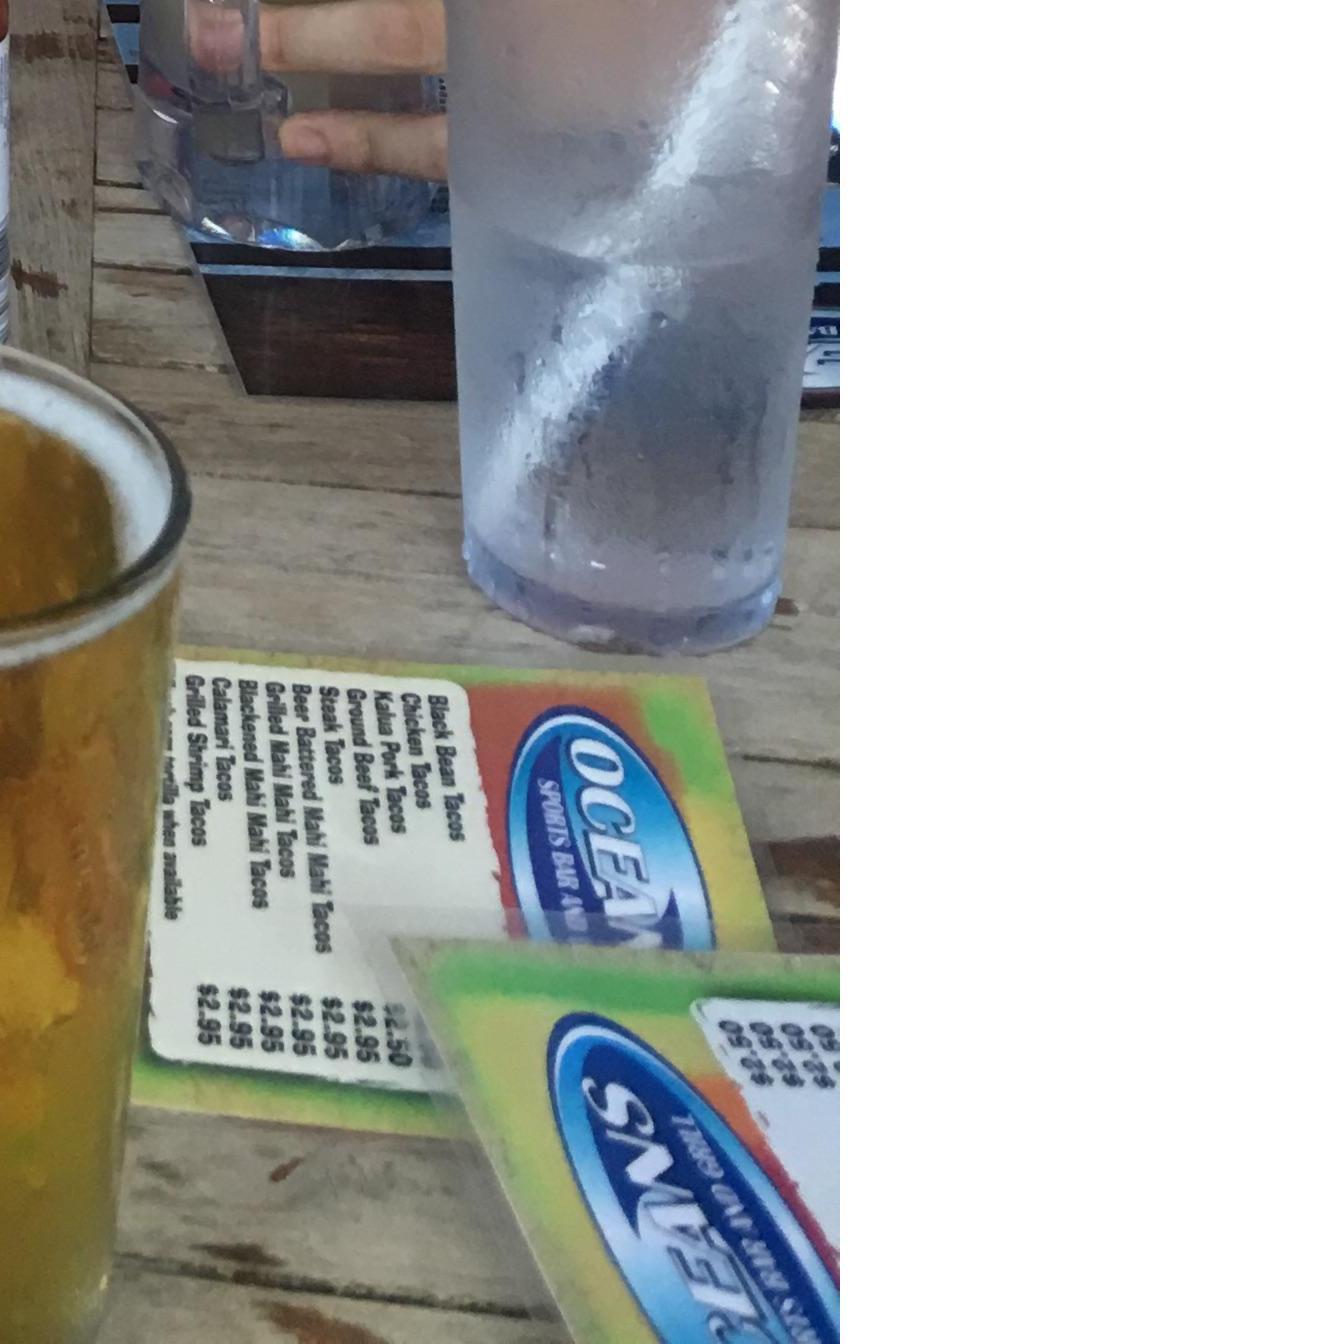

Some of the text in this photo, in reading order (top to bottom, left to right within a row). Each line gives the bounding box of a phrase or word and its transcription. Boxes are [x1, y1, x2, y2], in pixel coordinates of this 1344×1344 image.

[346, 688, 373, 748] Ground
[353, 752, 379, 794] Beef
[373, 690, 408, 834] Kalua Pork Tacos
[400, 692, 431, 810] Chicken Tacos
[427, 694, 465, 842] Black Bean Tacos
[162, 810, 179, 848] when
[184, 674, 222, 1046] Grilled Shrimp Tacos $2.95
[212, 677, 253, 1050] Calamari Tacos $2.95
[238, 679, 285, 1053] Blackened Mahi Mahi Tacos $2.95
[265, 681, 316, 1057] Grilled Mahi Mahi Tacos $2.95
[291, 683, 348, 1060] Beer Battered Mahi Mahi Tacos $2.95
[359, 797, 380, 845] Tacos
[537, 777, 572, 849] SPORTS
[551, 851, 581, 891] BAR
[569, 737, 663, 949] OCEAN
[163, 851, 183, 920] available
[319, 685, 380, 1063] Steak Tacos $2.95
[718, 1019, 775, 1087] $2.50
[749, 1021, 806, 1088] $2.50
[779, 1022, 837, 1090] $2.50
[581, 1076, 772, 1344] CEANS
